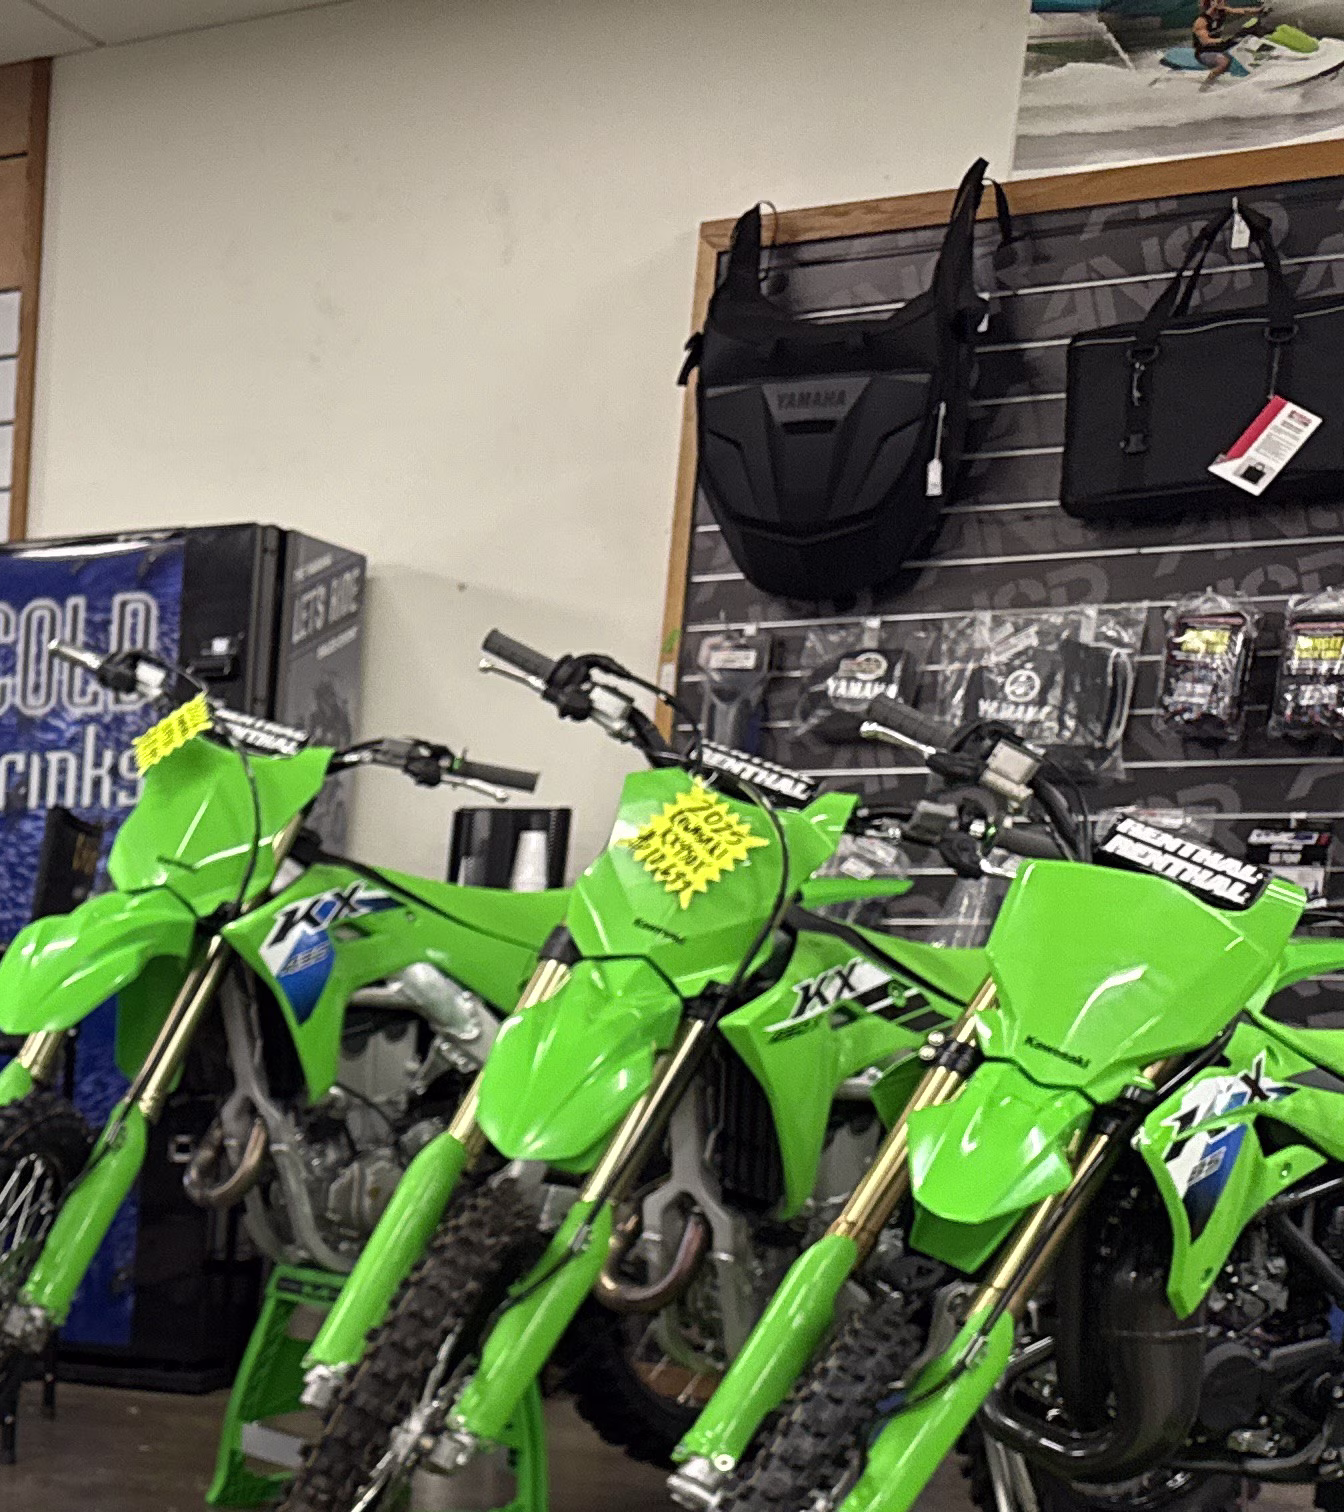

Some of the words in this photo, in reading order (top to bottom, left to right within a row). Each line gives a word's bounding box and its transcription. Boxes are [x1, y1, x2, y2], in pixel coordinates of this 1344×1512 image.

[777, 389, 847, 411] YAMAHA
[1103, 833, 1247, 905] RENTHAL
[1116, 817, 1260, 885] RENTHAL
[268, 885, 360, 949] KX
[793, 962, 858, 1019] KX
